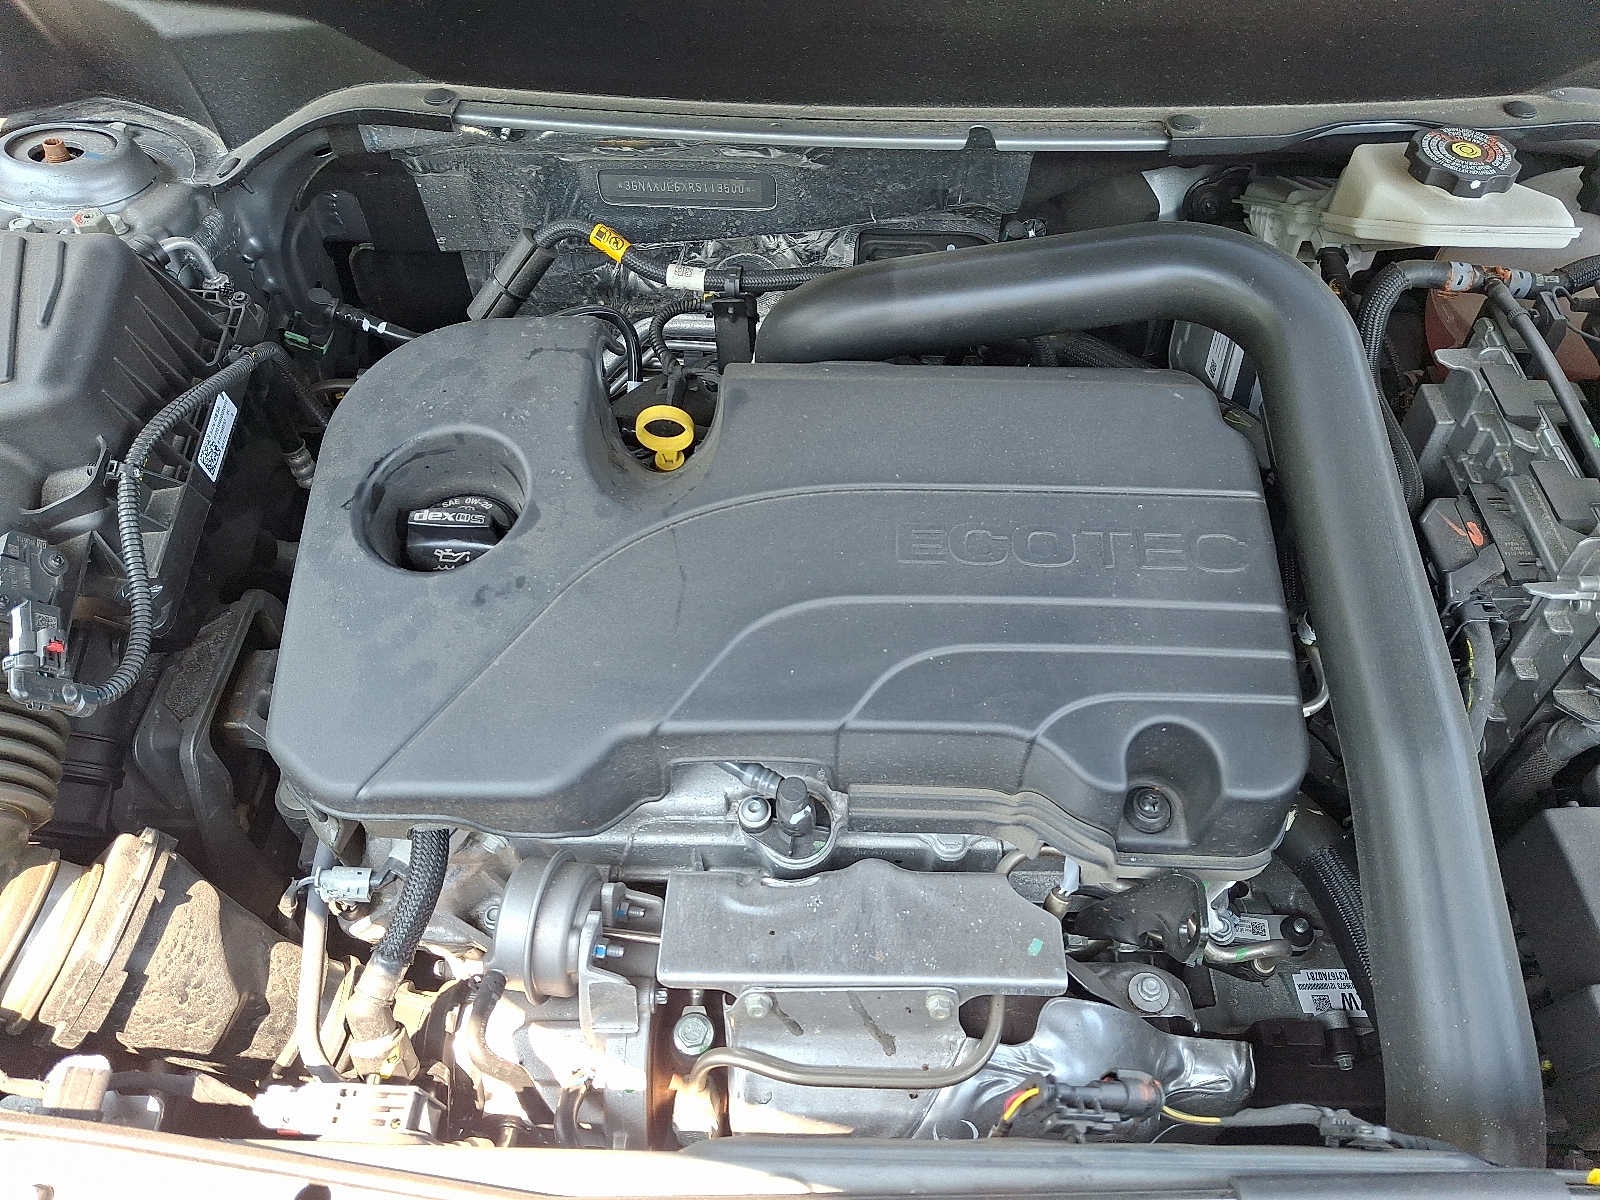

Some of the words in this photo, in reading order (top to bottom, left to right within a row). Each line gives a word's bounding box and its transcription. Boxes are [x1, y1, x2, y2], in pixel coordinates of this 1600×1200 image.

[442, 498, 461, 508] SAE
[465, 497, 493, 510] 0W-20
[896, 522, 1250, 574] ECOTEC
